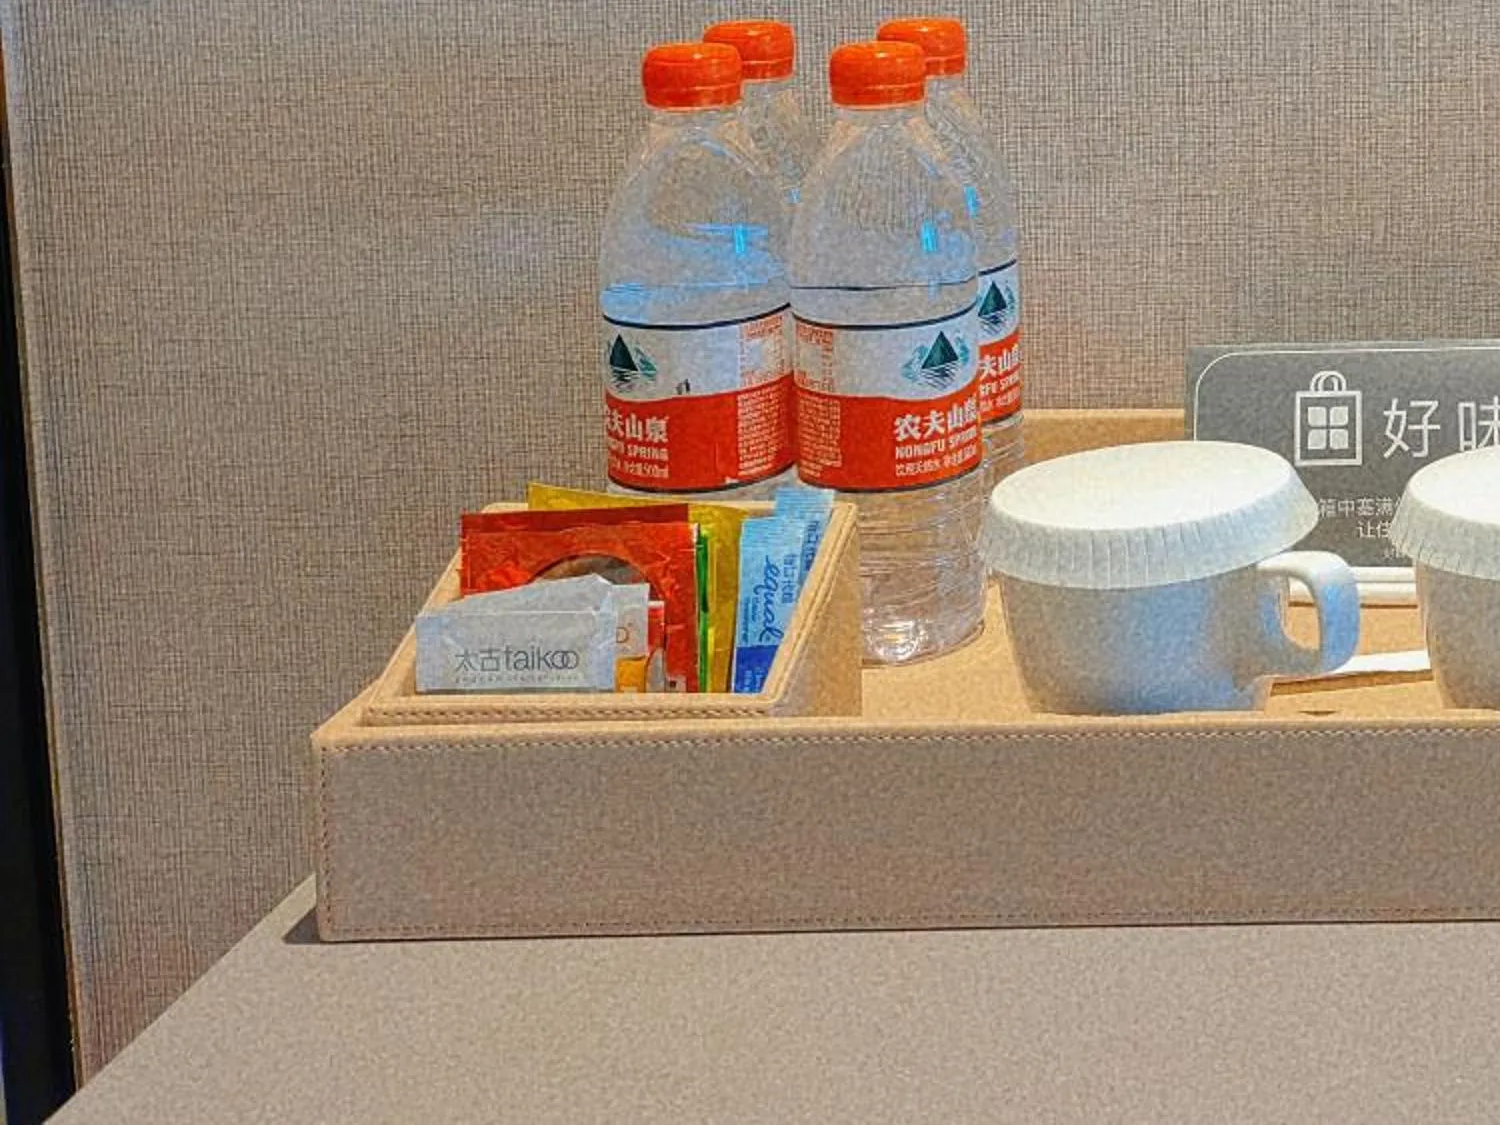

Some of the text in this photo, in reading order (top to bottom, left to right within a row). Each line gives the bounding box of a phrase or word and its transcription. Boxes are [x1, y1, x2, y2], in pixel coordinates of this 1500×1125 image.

[893, 392, 978, 443] 农夫山泉
[1319, 494, 1404, 517] 箱中塞满
[753, 555, 785, 643] equal
[455, 646, 580, 672] 太古 taikoo
